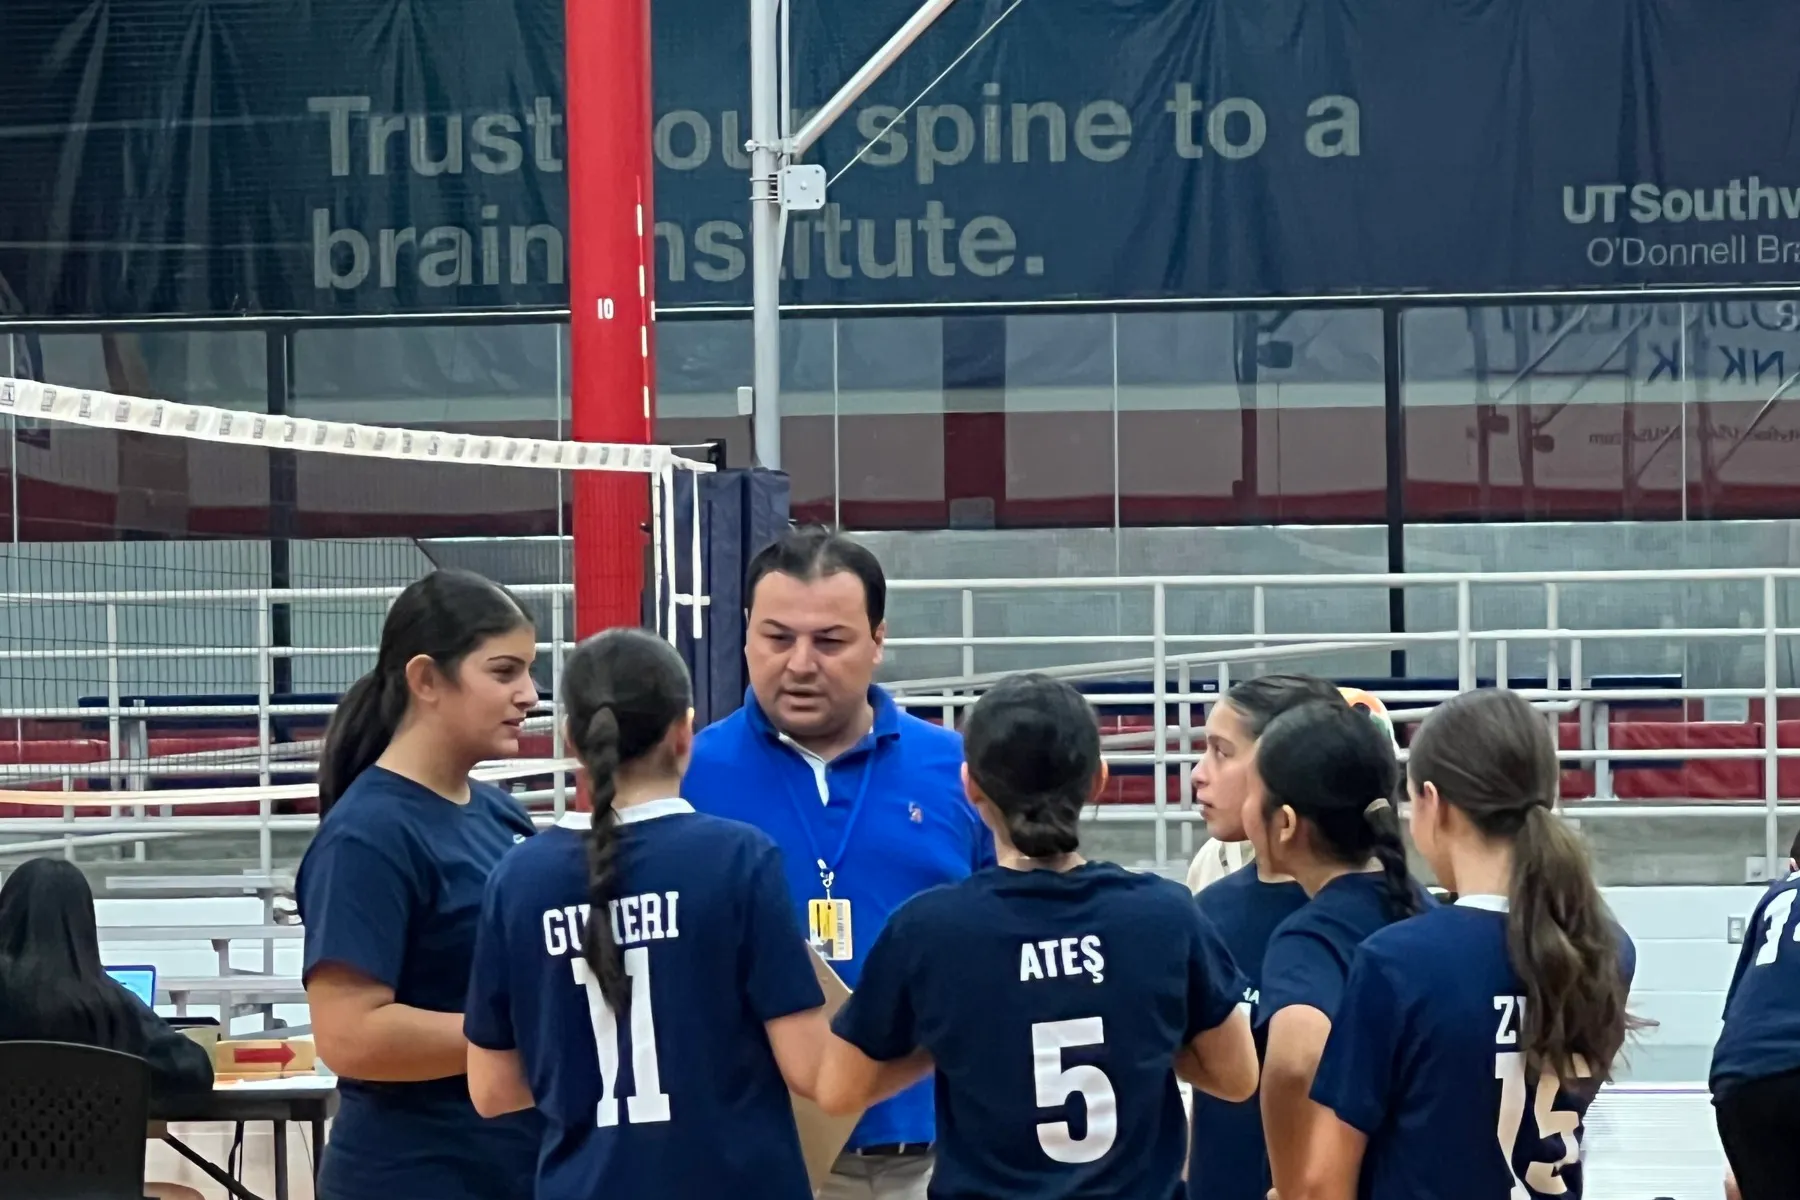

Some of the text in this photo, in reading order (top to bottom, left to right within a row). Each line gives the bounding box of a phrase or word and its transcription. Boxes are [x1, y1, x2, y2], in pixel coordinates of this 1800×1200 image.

[308, 96, 564, 176] Trust
[856, 82, 1133, 186] spine
[1165, 82, 1267, 160] to
[1304, 95, 1361, 158] a
[312, 204, 564, 290] brain
[1586, 234, 1746, 266] O'Donnell
[597, 297, 614, 320] 10
[1019, 934, 1105, 984] ATEŞ
[570, 946, 671, 1128] 11
[1031, 1016, 1118, 1164] 5
